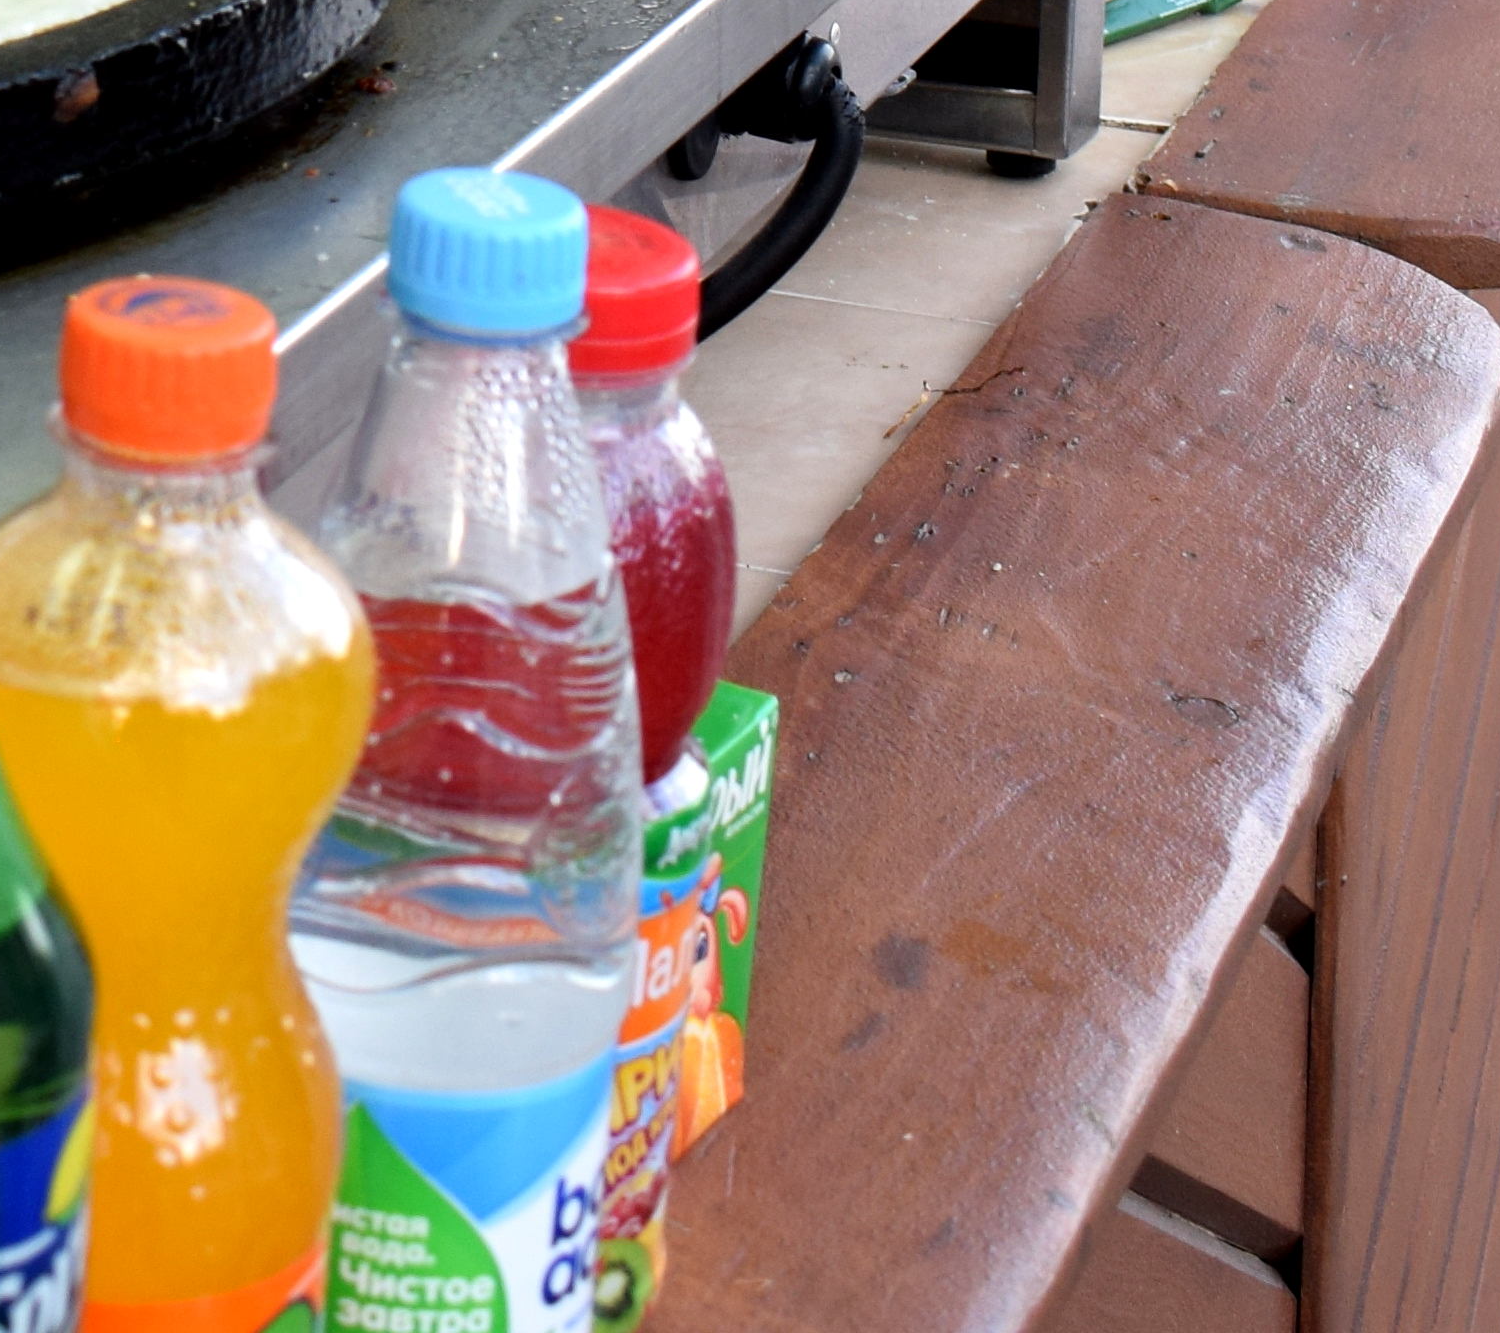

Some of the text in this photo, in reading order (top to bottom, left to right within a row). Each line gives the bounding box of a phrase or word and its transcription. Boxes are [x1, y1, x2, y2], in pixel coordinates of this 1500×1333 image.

[332, 1202, 430, 1239] истая
[337, 1258, 497, 1303] Чистое
[335, 1296, 493, 1333] завтра
